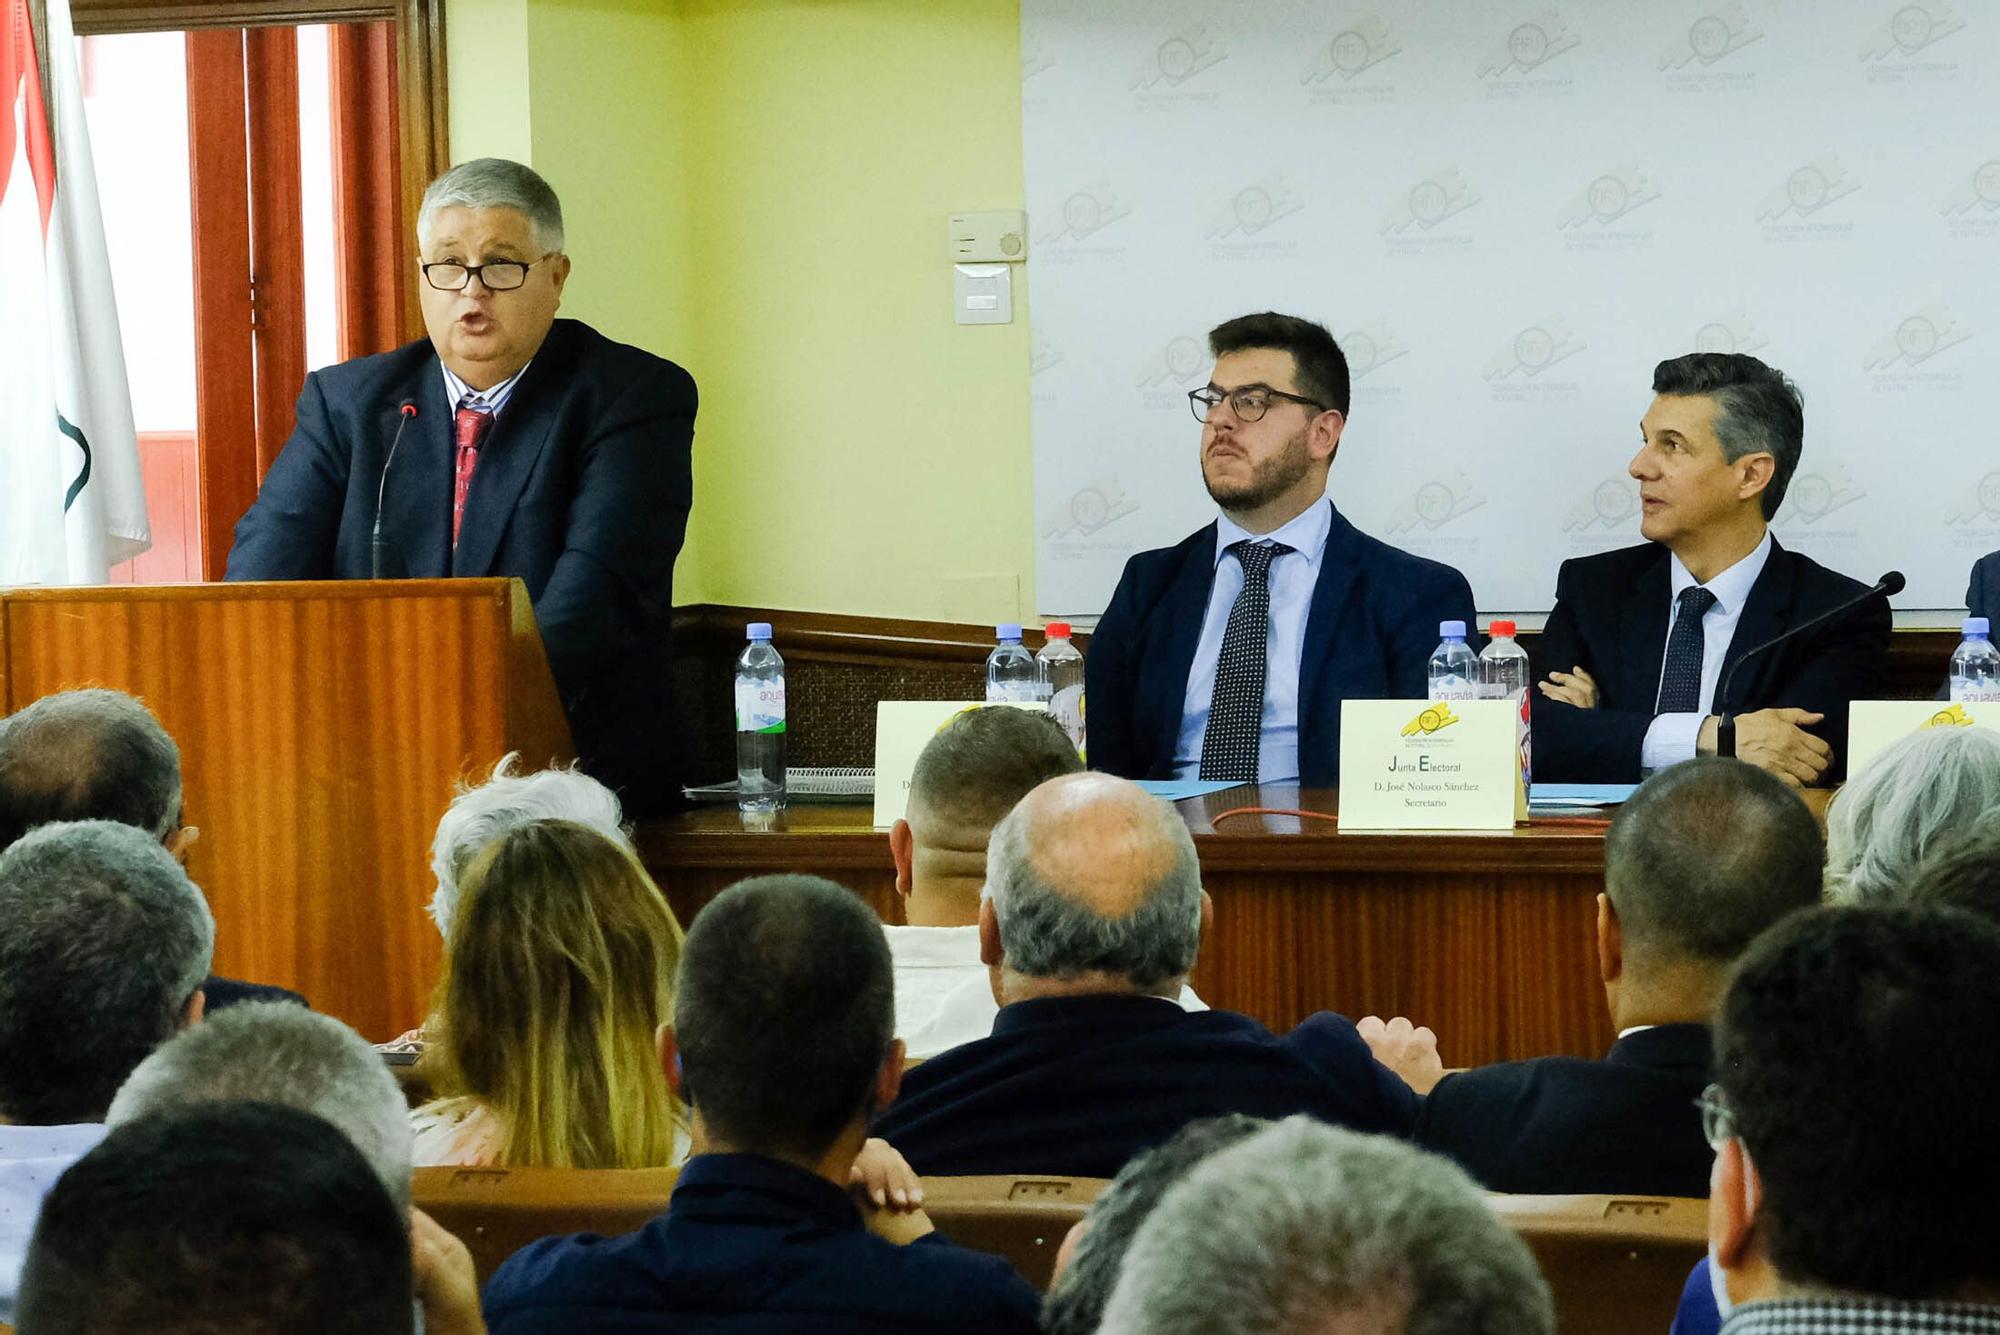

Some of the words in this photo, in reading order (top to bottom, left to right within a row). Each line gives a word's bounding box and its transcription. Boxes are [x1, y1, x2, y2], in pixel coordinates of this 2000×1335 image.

[1388, 755, 1416, 772] Junta
[1419, 755, 1461, 772] Electoral
[1374, 782, 1385, 791] D.
[1386, 781, 1405, 792] José
[1408, 782, 1442, 791] Nolasco
[1404, 798, 1447, 808] Secretario
